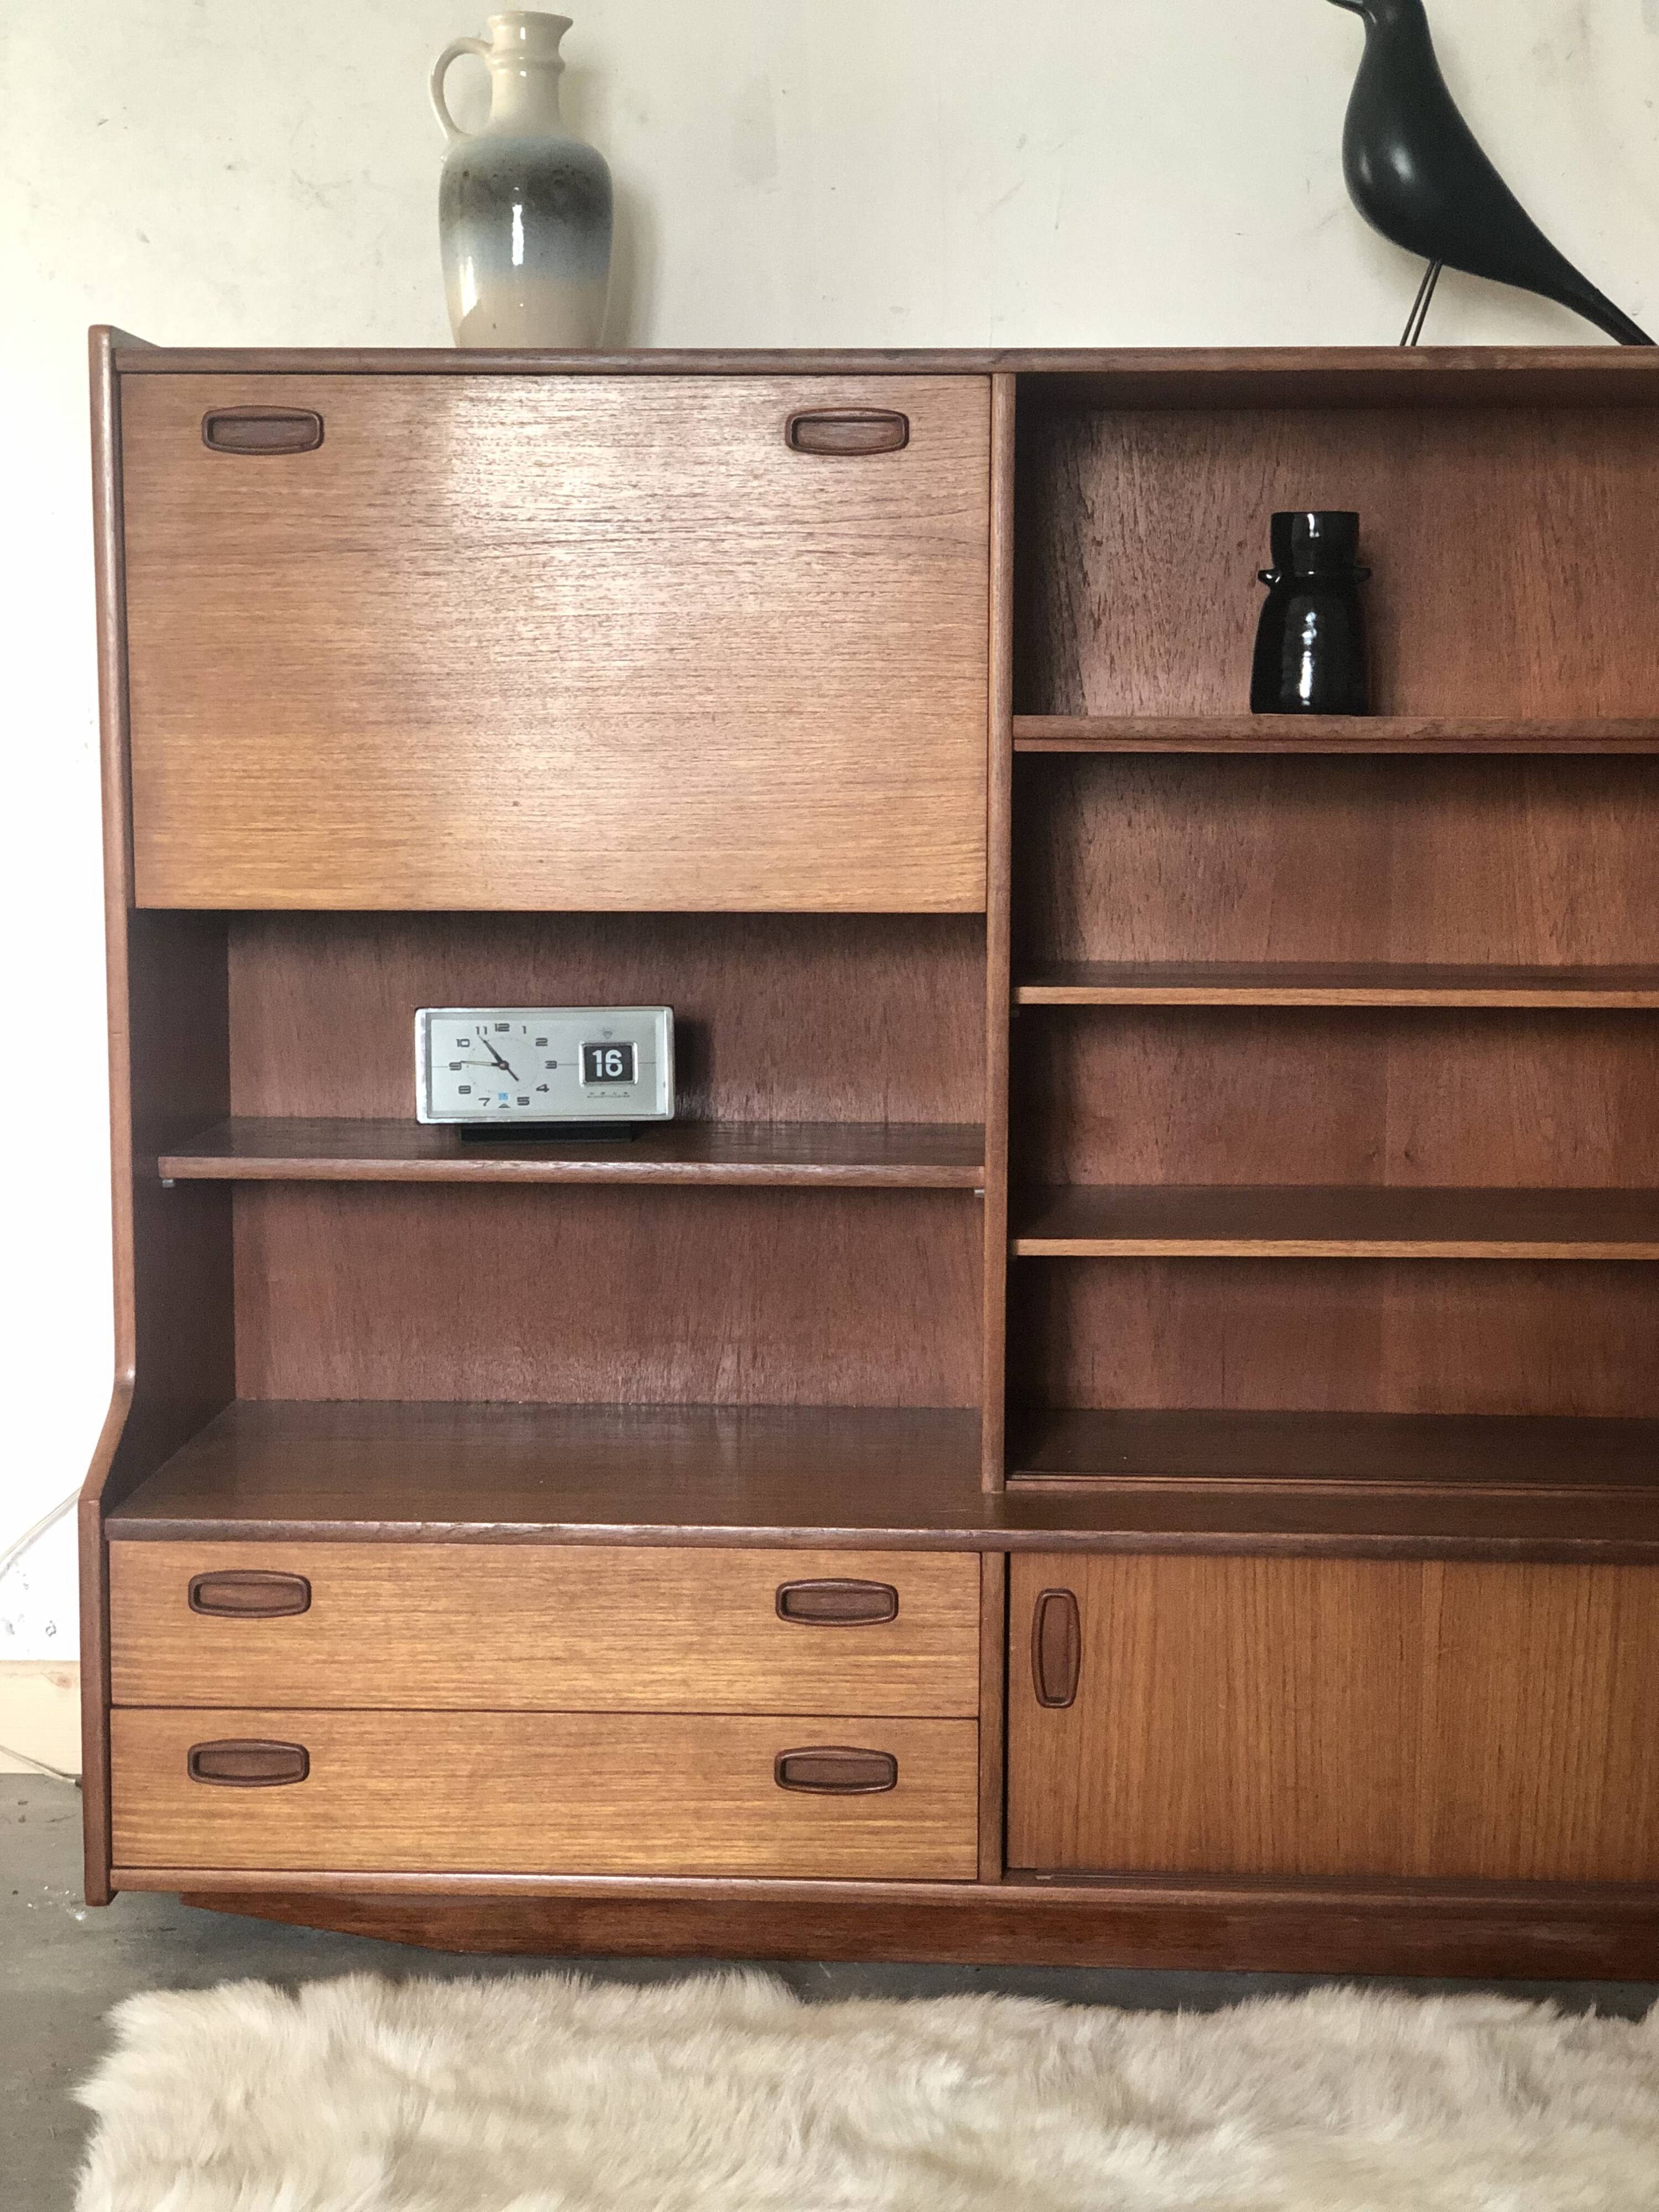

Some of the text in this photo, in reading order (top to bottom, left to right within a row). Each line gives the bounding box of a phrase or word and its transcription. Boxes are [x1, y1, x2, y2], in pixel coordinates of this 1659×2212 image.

[476, 1026, 488, 1035] 11
[494, 1023, 510, 1032] 12
[522, 1026, 526, 1034] 1
[456, 1039, 470, 1047] 10
[535, 1037, 548, 1046] 2
[449, 1062, 462, 1071] 9
[545, 1061, 557, 1069] 3
[592, 1050, 623, 1077] 16
[458, 1086, 471, 1094] 8
[536, 1084, 550, 1093] 4
[478, 1098, 490, 1107] 7
[517, 1097, 530, 1106] 5
